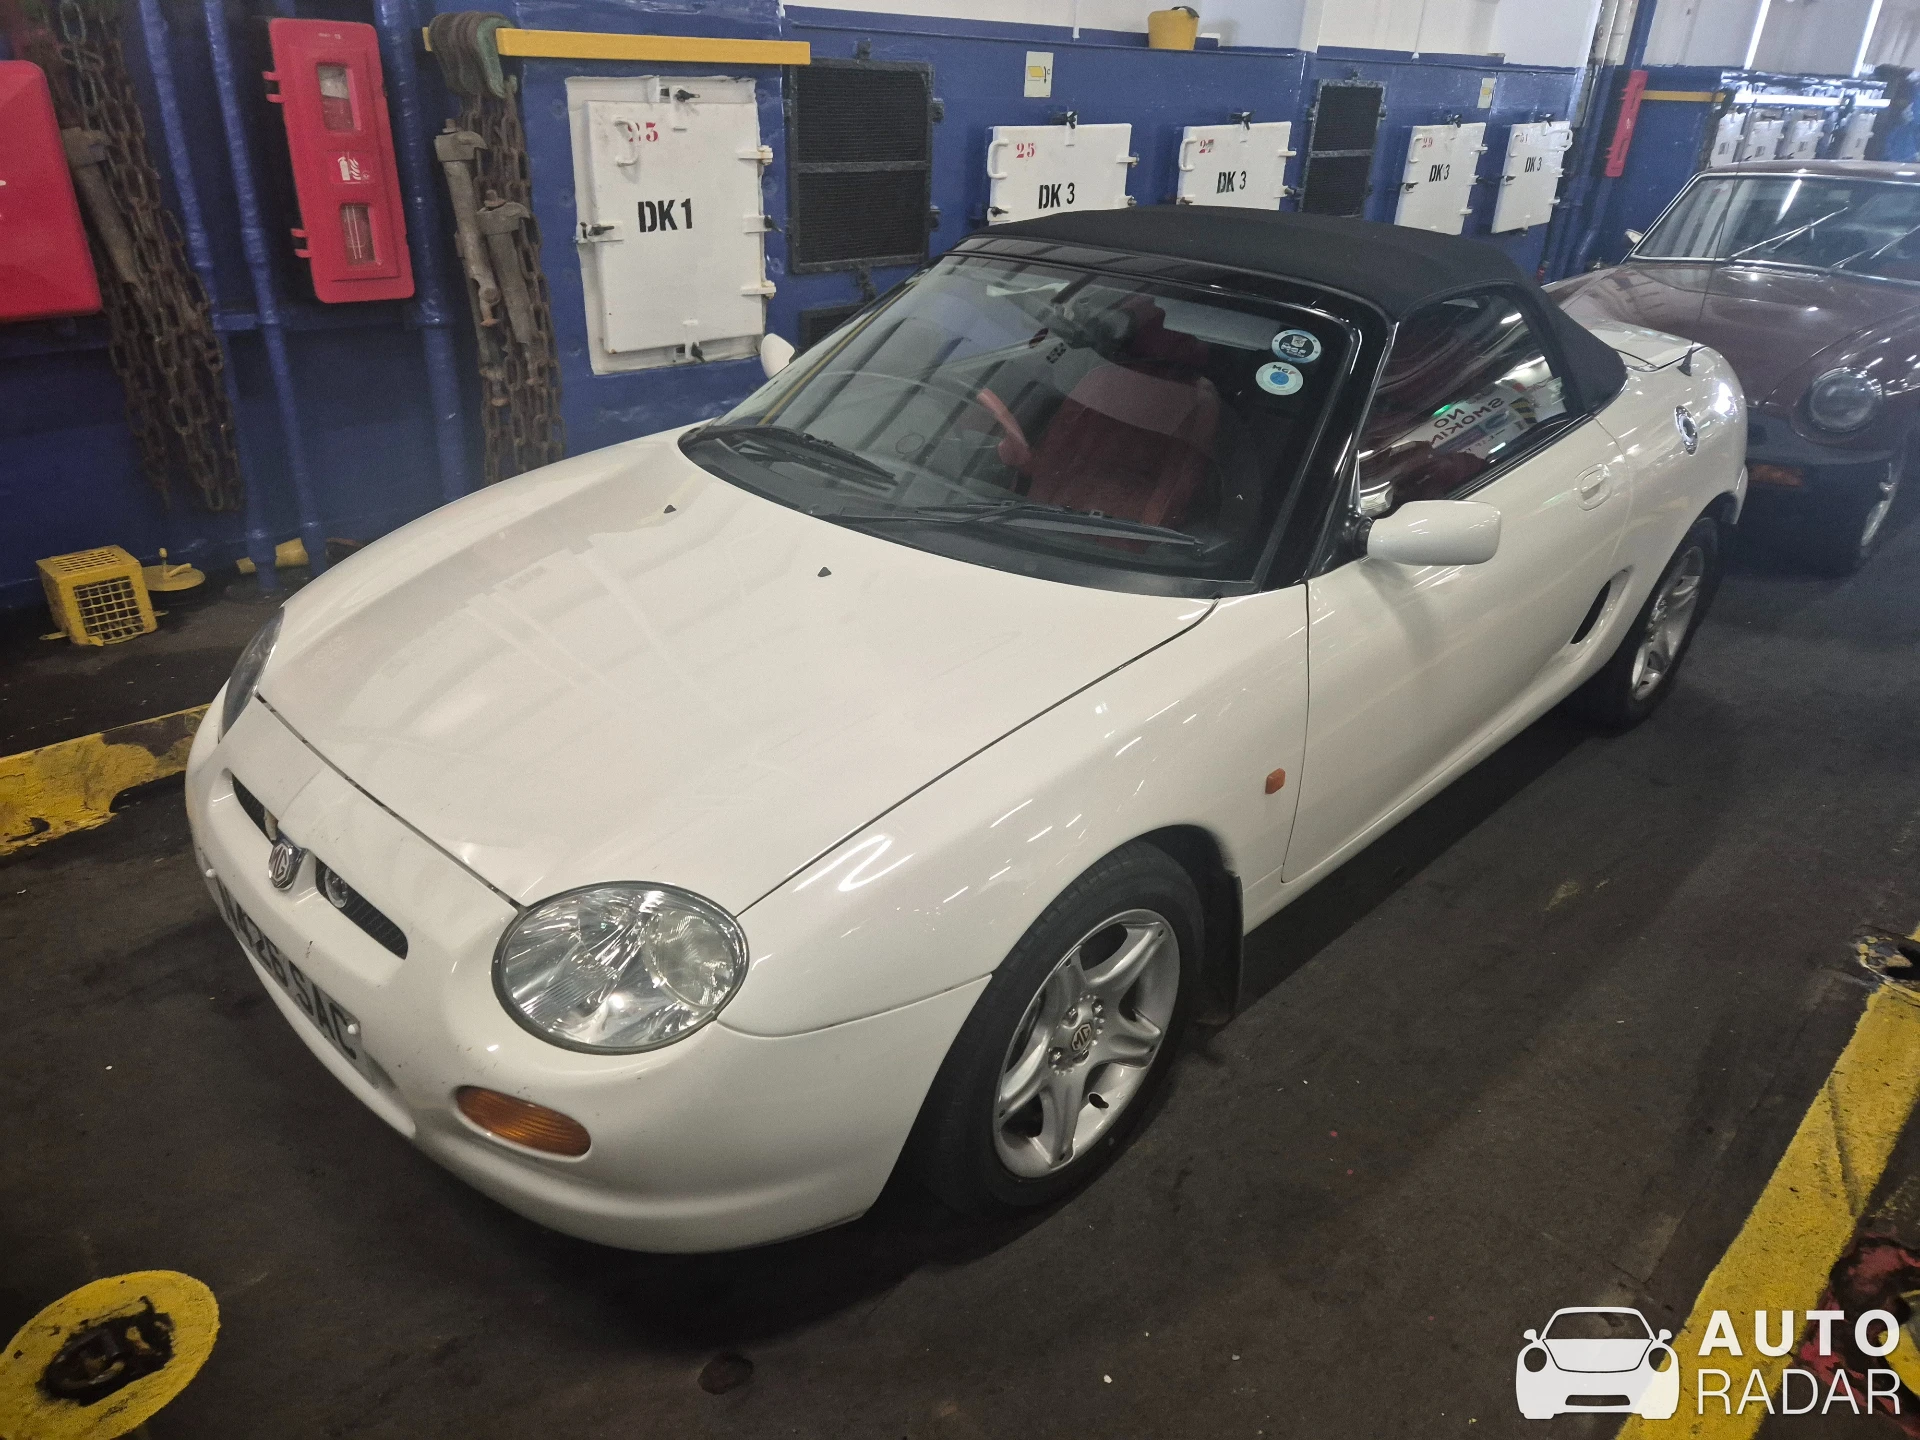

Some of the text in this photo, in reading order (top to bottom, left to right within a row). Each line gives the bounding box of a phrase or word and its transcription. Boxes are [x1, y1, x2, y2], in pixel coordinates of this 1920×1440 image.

[1016, 143, 1035, 158] 25
[1429, 163, 1450, 182] DK 3
[1524, 156, 1543, 173] DK 3
[1216, 170, 1246, 194] DK 3
[1038, 182, 1075, 209] DK 3
[270, 845, 288, 880] MG
[289, 960, 357, 1060] SAC
[1073, 1025, 1091, 1049] MG
